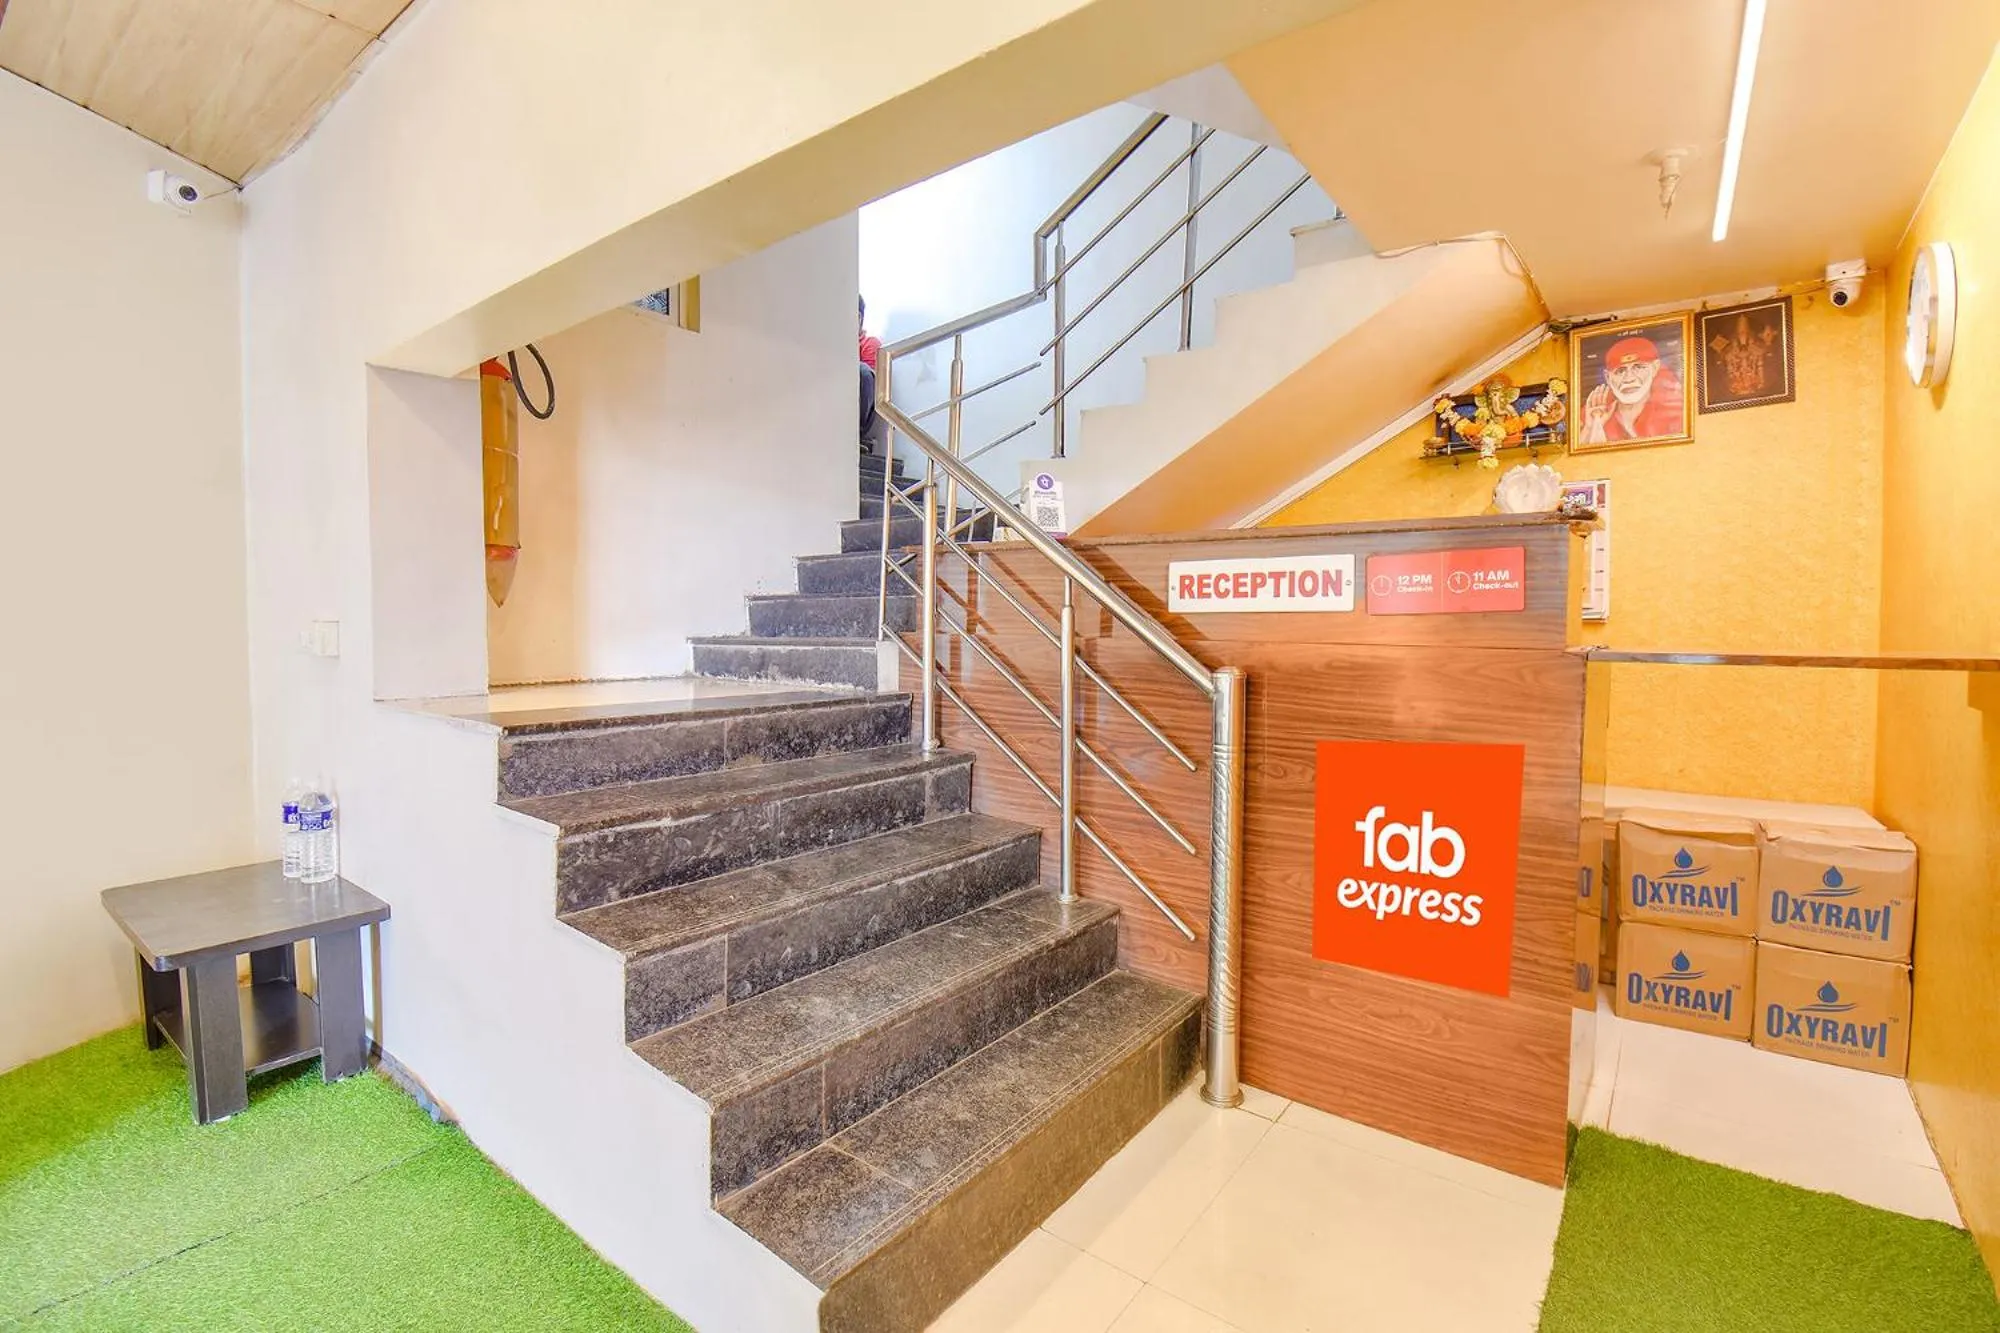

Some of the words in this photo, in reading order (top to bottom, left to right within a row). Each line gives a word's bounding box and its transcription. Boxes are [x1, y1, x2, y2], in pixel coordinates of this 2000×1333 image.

[1179, 569, 1343, 600] RECEPTION
[1397, 575, 1410, 585] 12
[1413, 574, 1433, 585] PM
[1397, 585, 1434, 593] Check-in
[1472, 581, 1519, 590] Check-out
[1473, 571, 1484, 581] 11
[1487, 570, 1510, 581] AM
[1355, 805, 1466, 878] fab
[1337, 877, 1484, 927] express
[1632, 874, 1738, 917] OXYRAVI
[1771, 889, 1891, 941] OXYRAVI
[1628, 972, 1733, 1021] OXYRAVI
[1767, 1004, 1888, 1058] OXYRAVI
